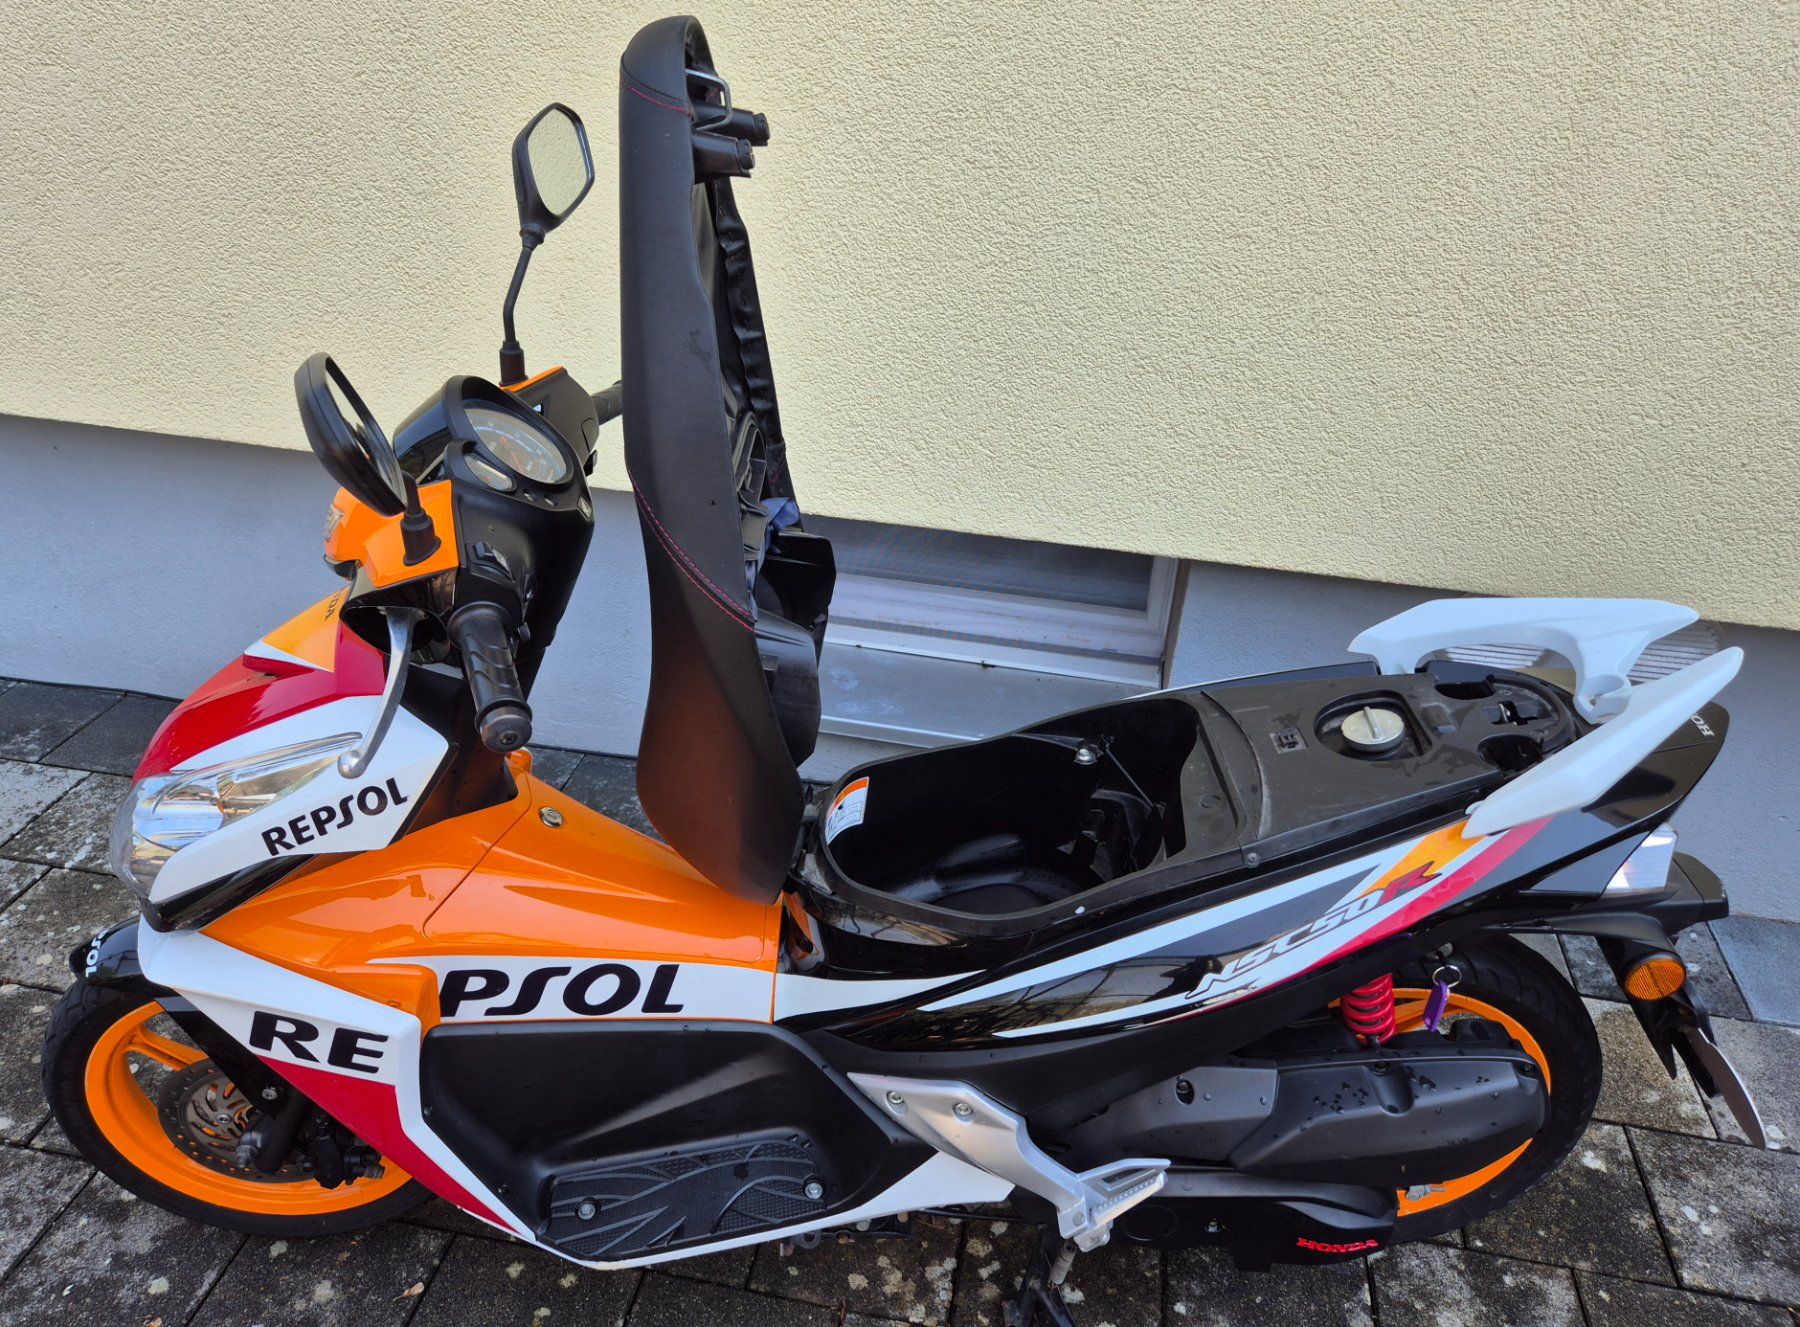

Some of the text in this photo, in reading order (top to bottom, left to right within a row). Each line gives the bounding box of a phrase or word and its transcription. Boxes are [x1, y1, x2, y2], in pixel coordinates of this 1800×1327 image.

[261, 777, 409, 857] REPSOL
[1184, 860, 1443, 1000] NSC50R
[249, 963, 686, 1074] RE PSOL
[1297, 1237, 1379, 1253] HONDA
